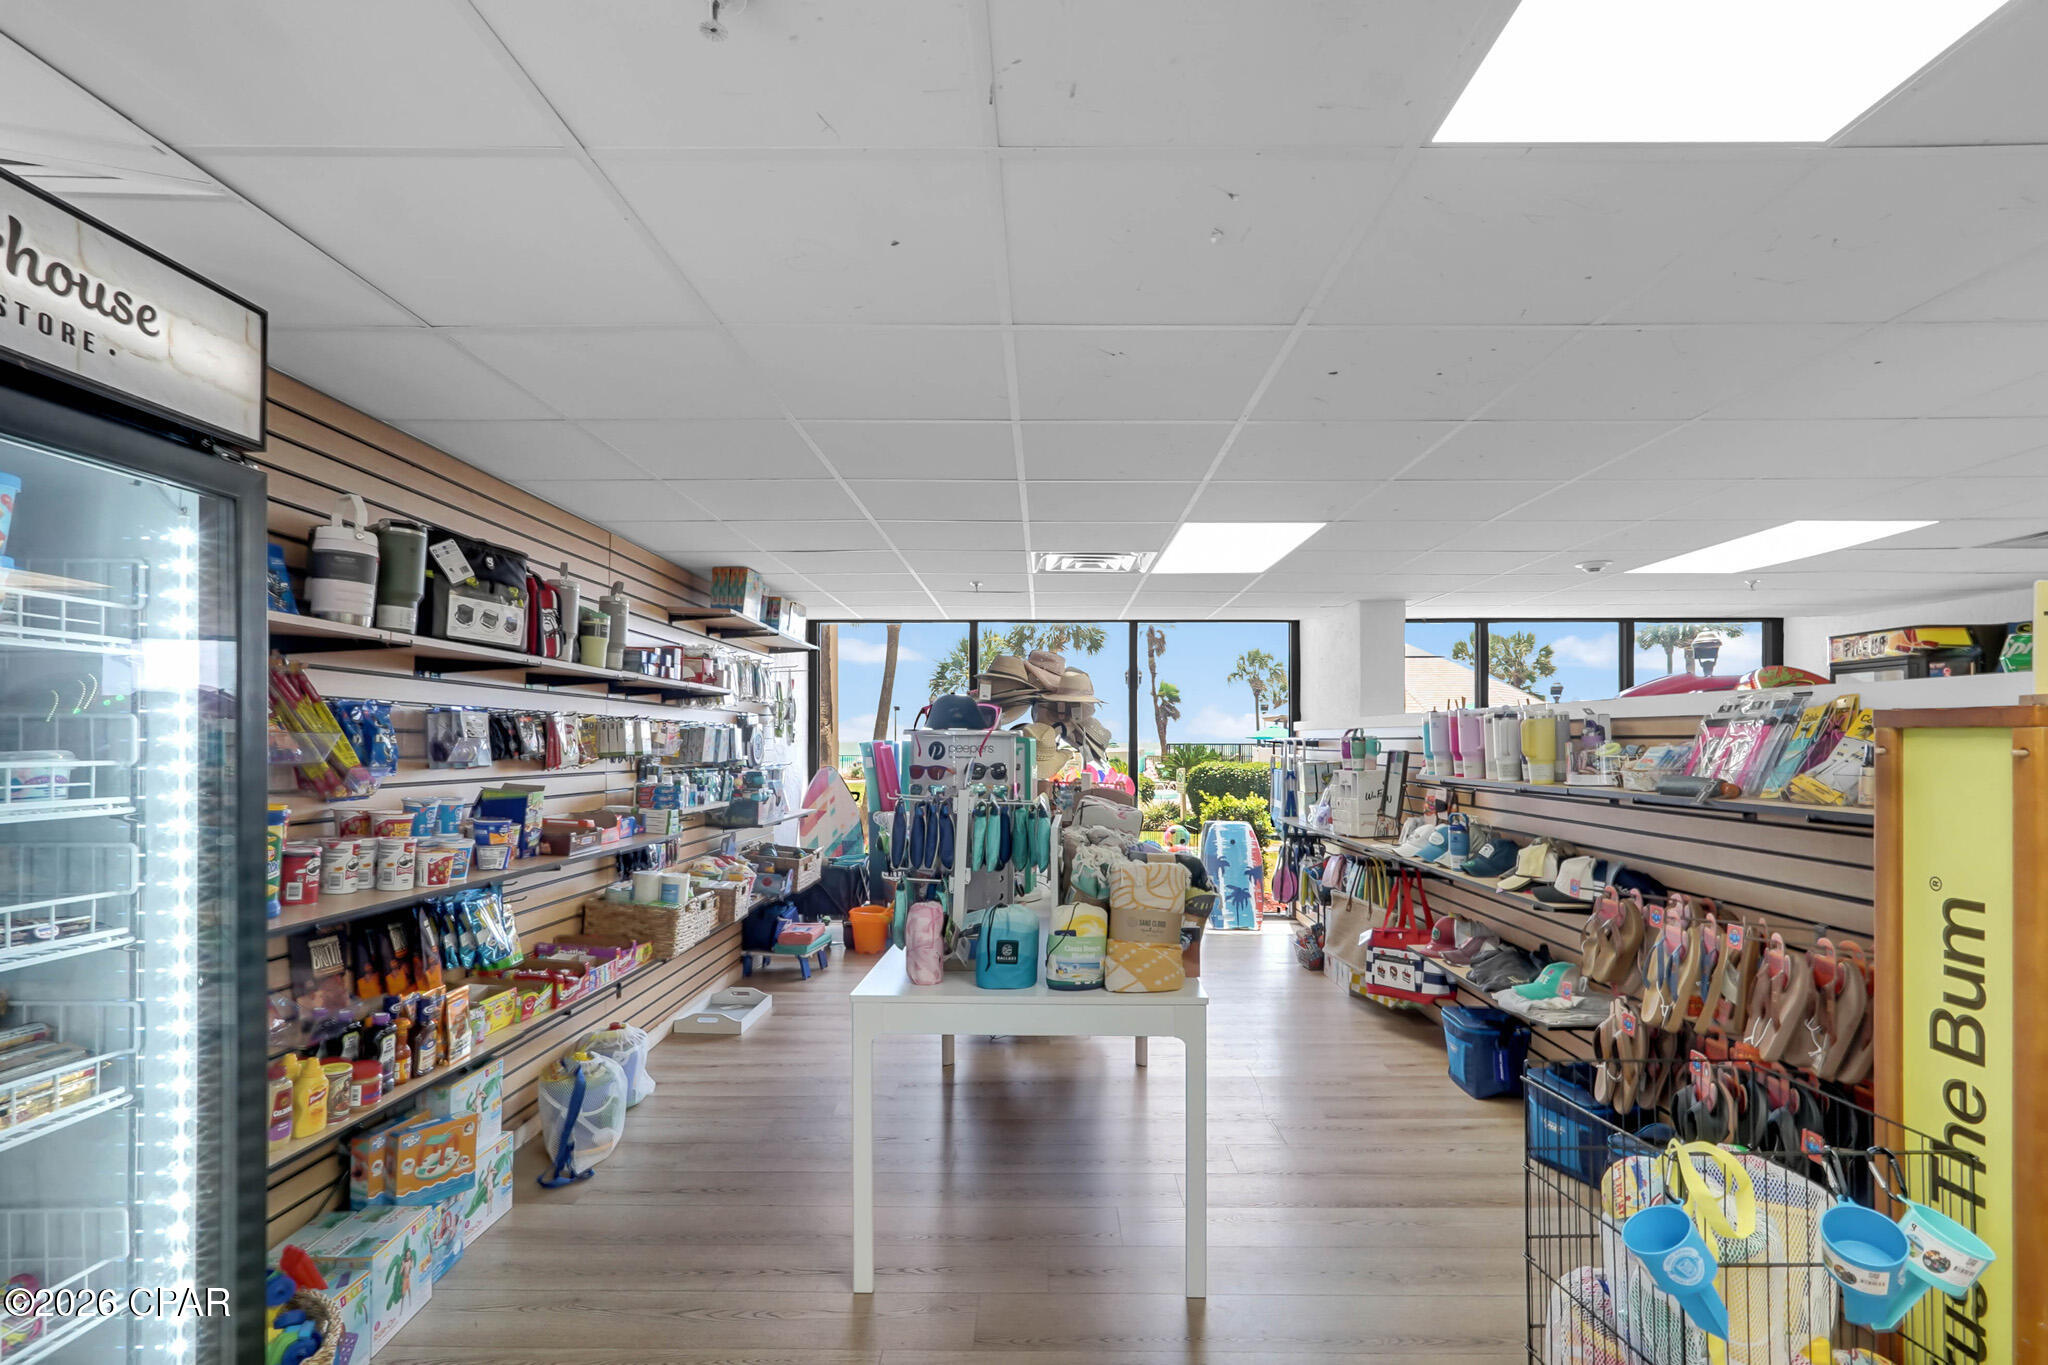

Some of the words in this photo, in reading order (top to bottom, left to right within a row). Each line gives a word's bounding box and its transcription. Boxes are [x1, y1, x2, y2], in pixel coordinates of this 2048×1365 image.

[0, 215, 160, 337] house
[948, 744, 994, 757] peeprs
[1929, 1078, 1988, 1210] The
